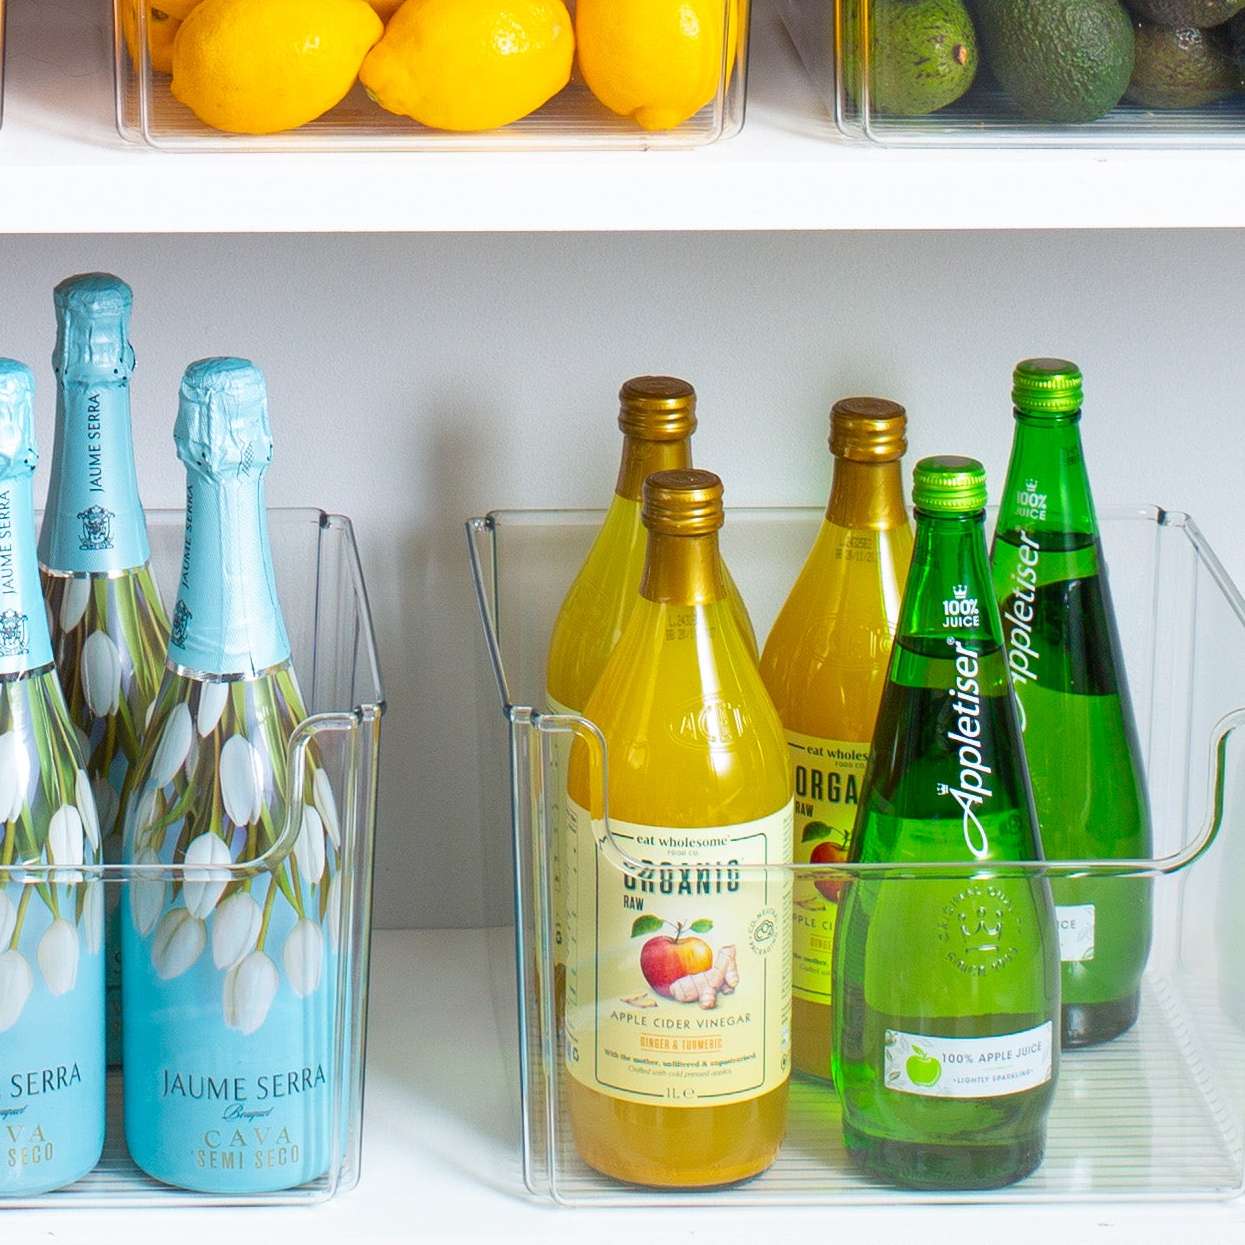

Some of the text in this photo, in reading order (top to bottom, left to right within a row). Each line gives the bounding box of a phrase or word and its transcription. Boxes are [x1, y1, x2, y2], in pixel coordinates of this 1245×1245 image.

[87, 393, 104, 492] JAUME SERRA
[1016, 490, 1047, 509] 100%
[1015, 507, 1046, 521] JUICE
[943, 599, 979, 615] 100%
[943, 615, 980, 628] JUICE
[806, 745, 823, 756] eat
[948, 639, 993, 861] Appletiser
[795, 800, 813, 818] RAW
[636, 835, 728, 848] eat wholesome
[623, 894, 644, 912] RAW
[610, 1010, 751, 1030] APPLE CIDER VINEGAR
[640, 1036, 723, 1051] GINGER & TURMERIC
[942, 1041, 1042, 1064] 100% APPLE JUICE
[10, 1061, 82, 1098] SERRA
[162, 1063, 326, 1101] JAUME SERRA
[204, 1126, 292, 1149] CAVA
[8, 1142, 53, 1167] SECO
[197, 1144, 300, 1170] SEMI SECO
